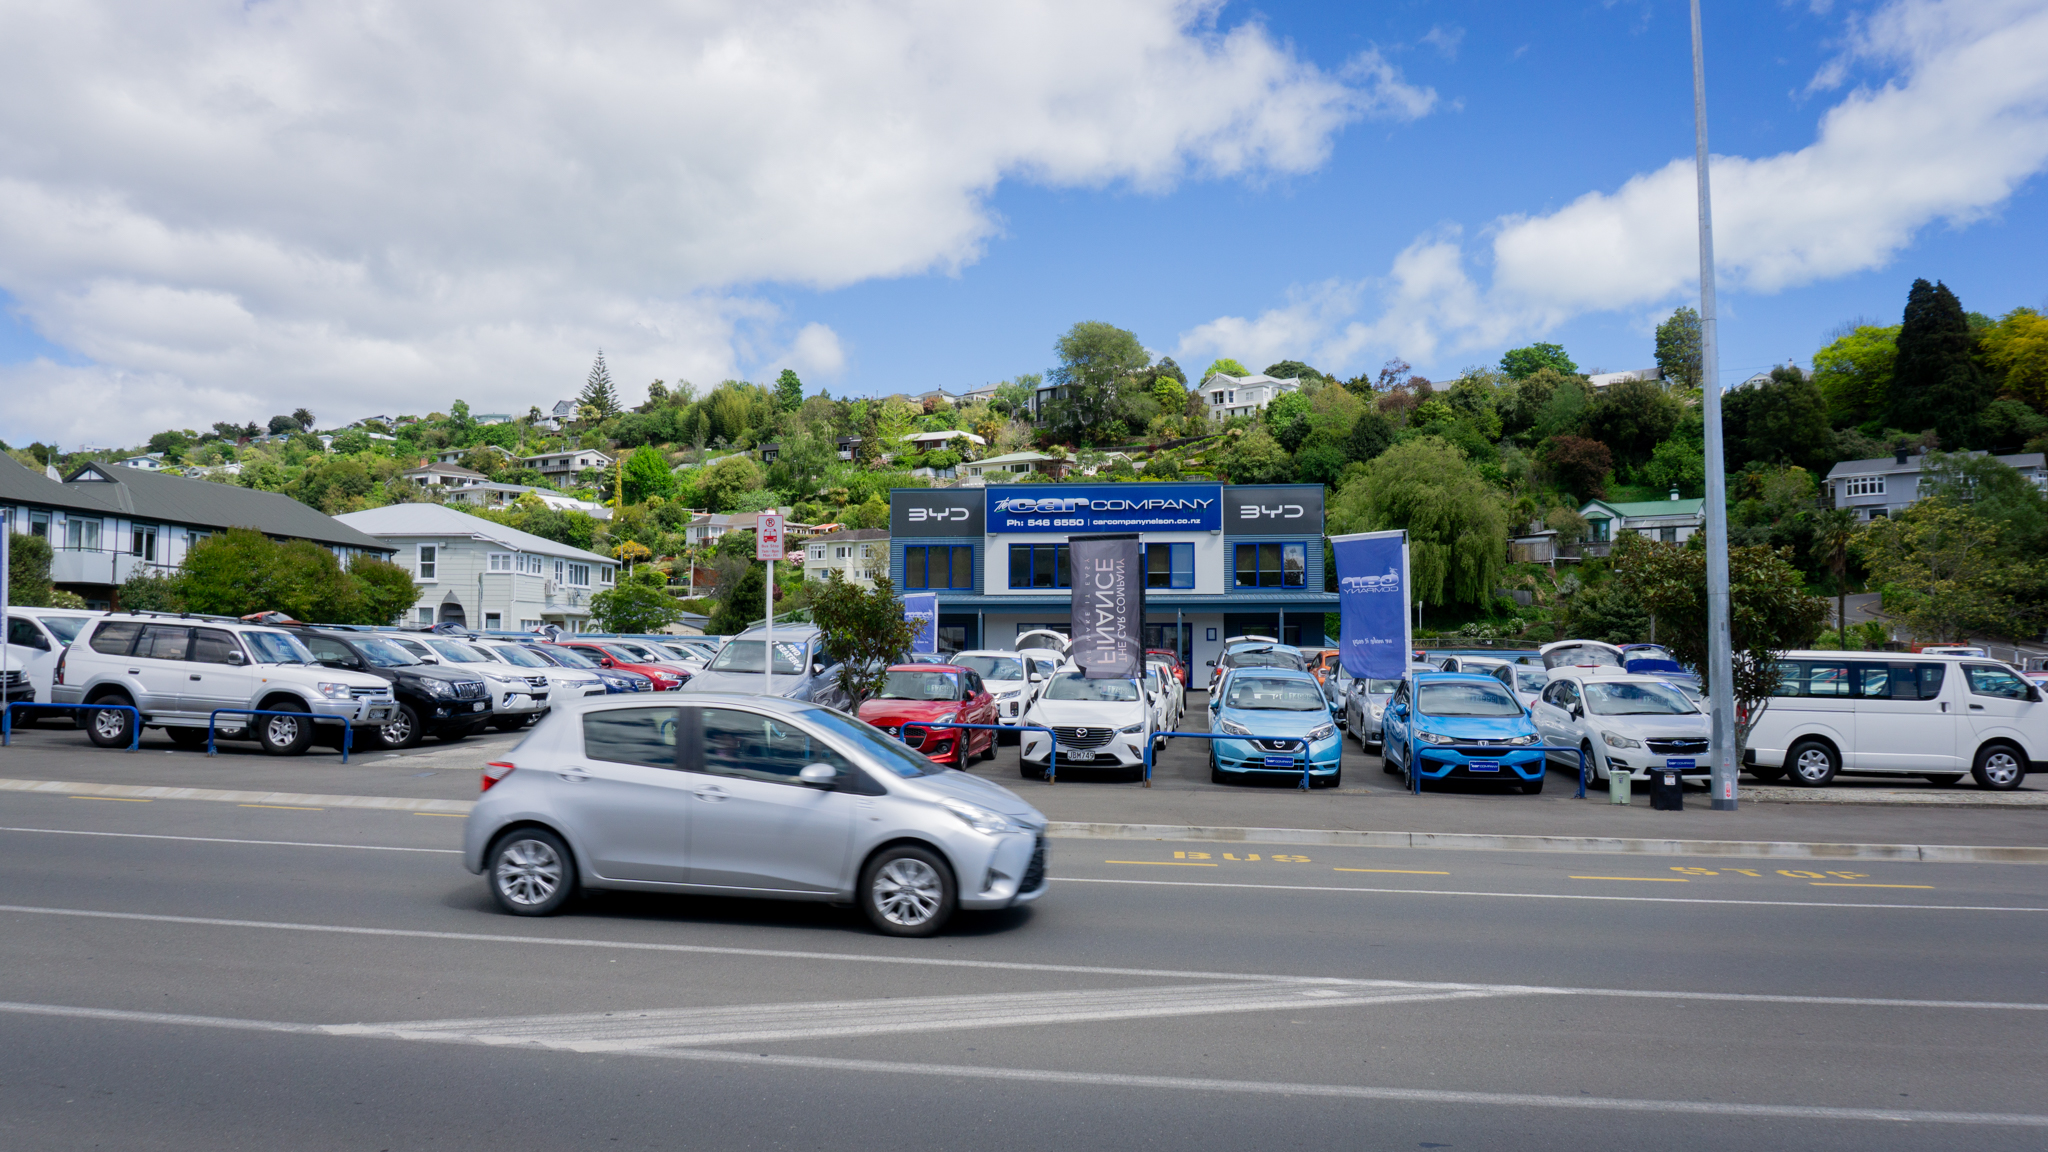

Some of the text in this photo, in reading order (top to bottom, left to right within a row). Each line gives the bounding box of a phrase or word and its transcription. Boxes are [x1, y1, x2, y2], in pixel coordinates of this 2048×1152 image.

[1008, 498, 1089, 514] car
[1090, 498, 1214, 511] COMPANY
[1240, 504, 1304, 518] BYD
[908, 508, 970, 521] BYD
[1028, 518, 1050, 526] 546
[1054, 518, 1084, 526] 6550
[1092, 518, 1201, 526] carcompanynelson.co.nz
[776, 644, 799, 665] SEATER
[787, 644, 801, 656] 4WD
[1068, 751, 1094, 759] JBM749
[1174, 851, 1311, 862] BUS
[1670, 867, 1870, 879] STOP
